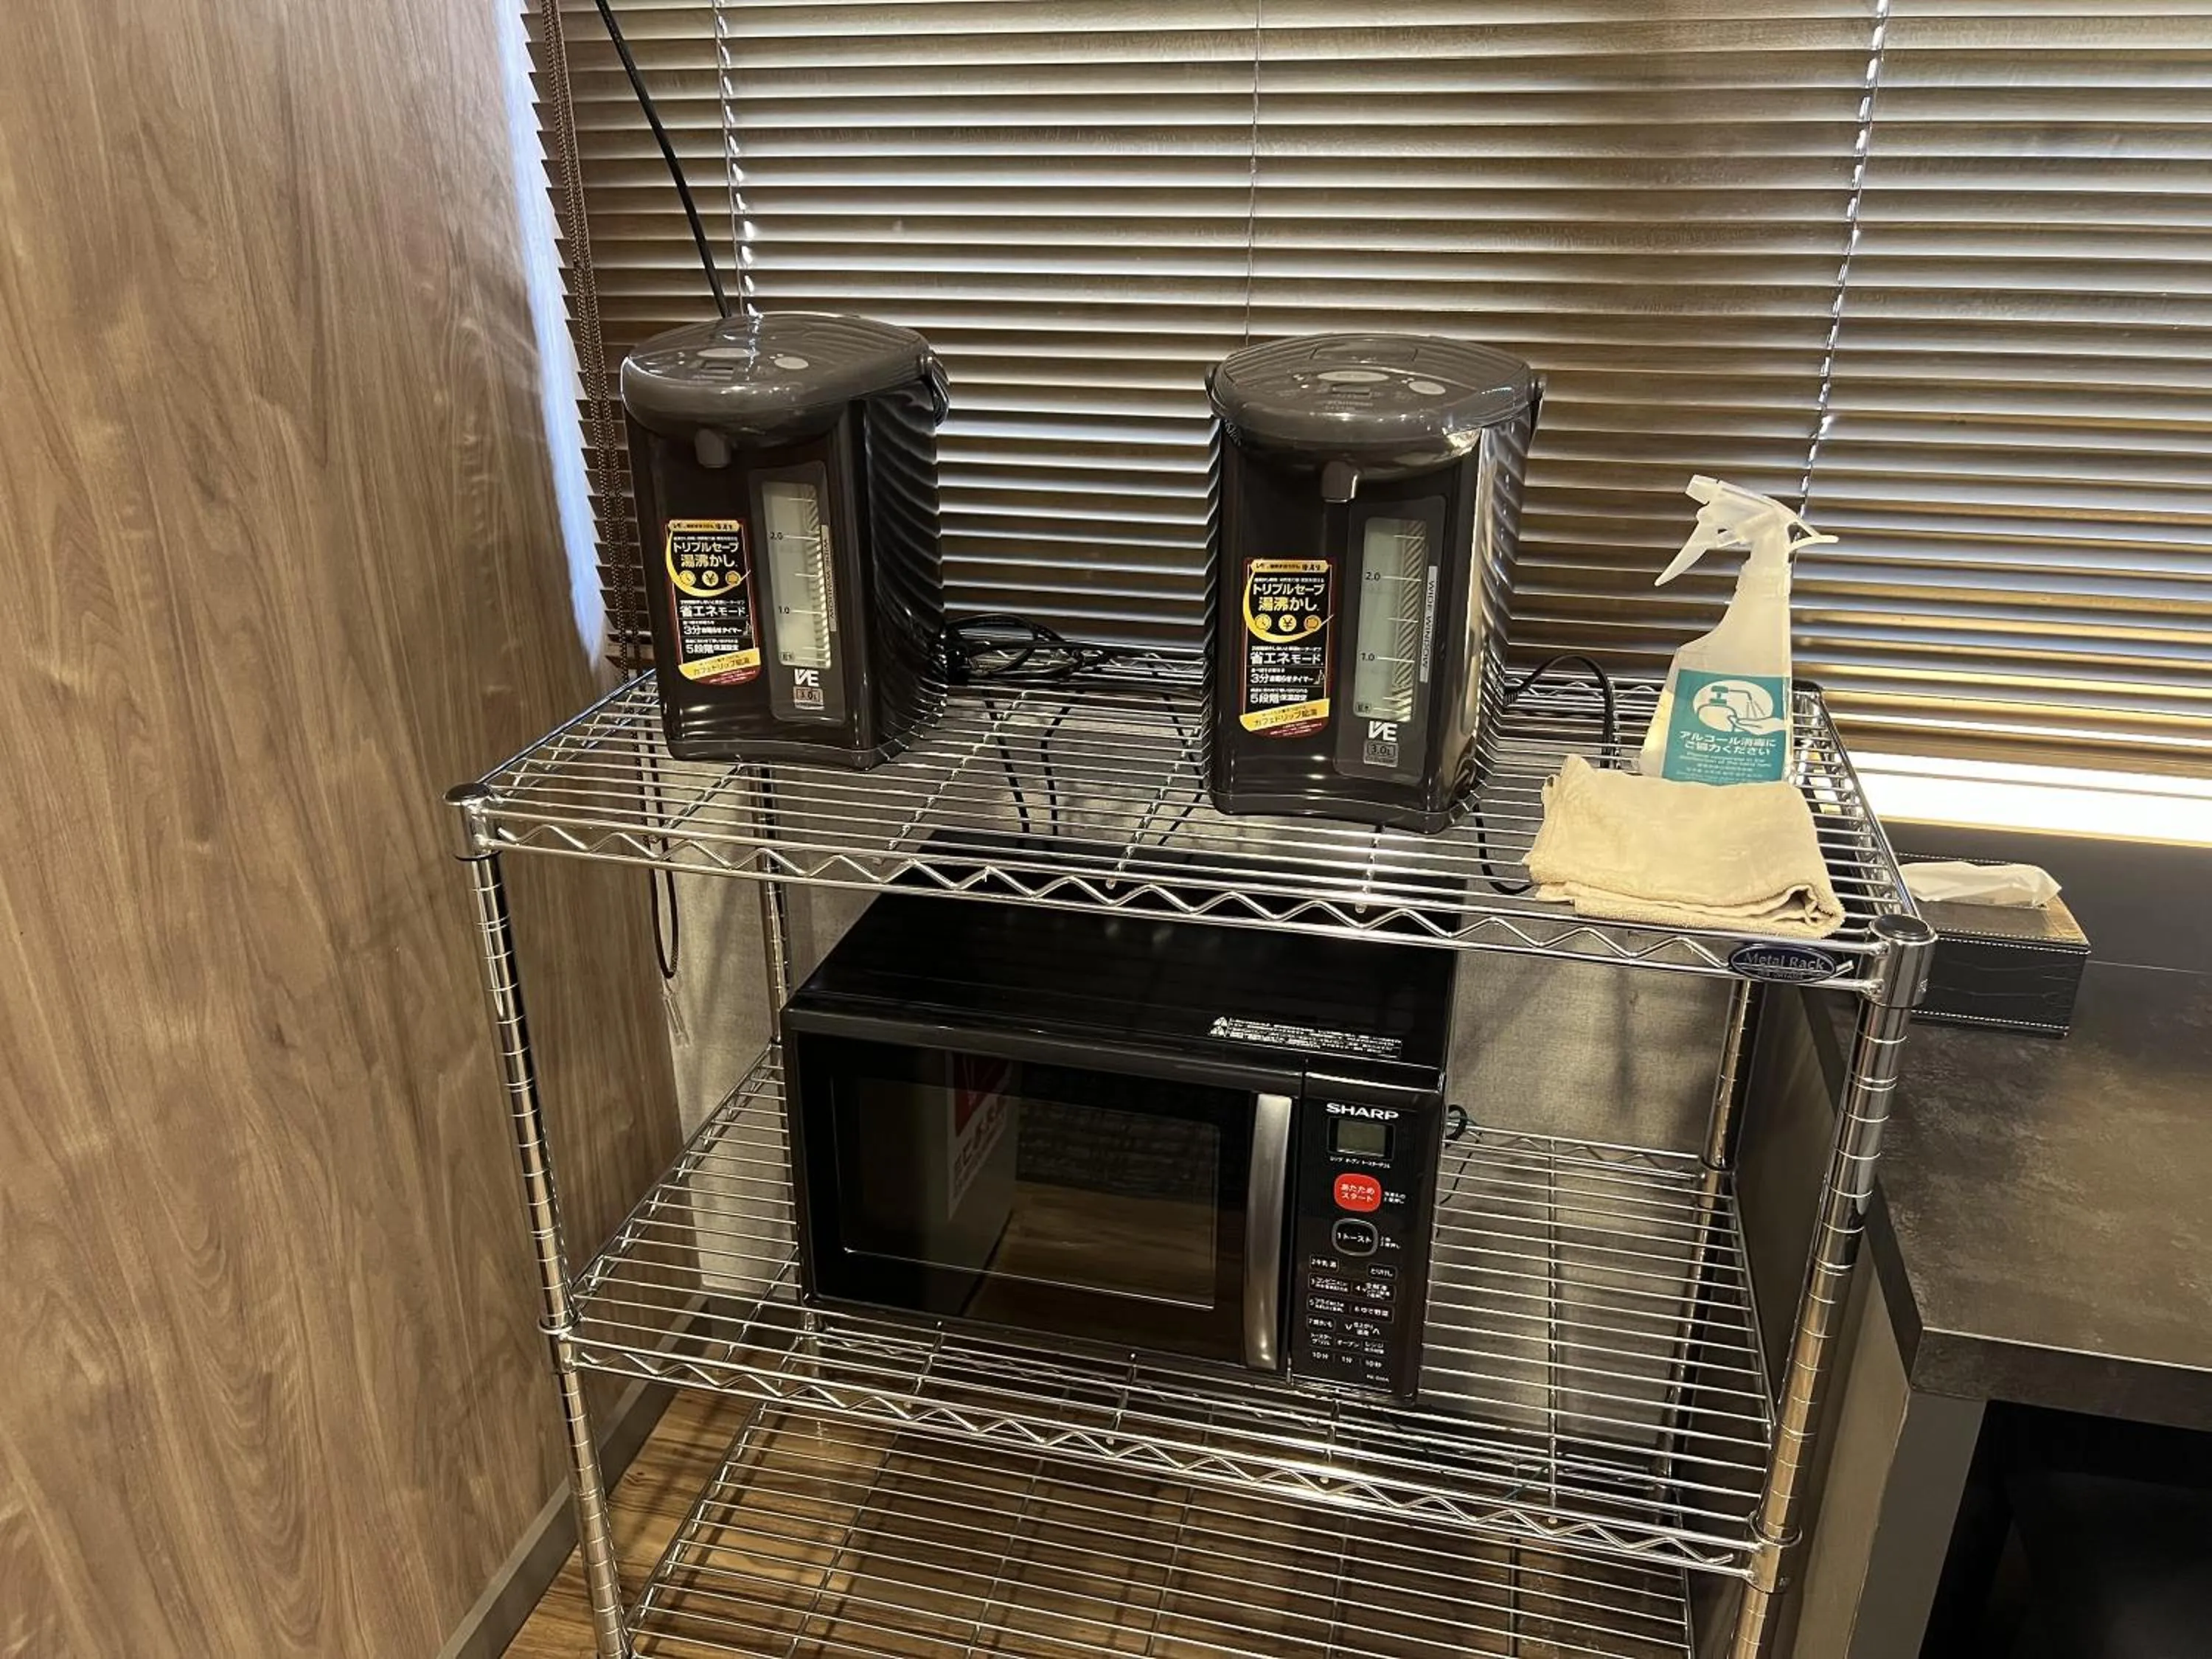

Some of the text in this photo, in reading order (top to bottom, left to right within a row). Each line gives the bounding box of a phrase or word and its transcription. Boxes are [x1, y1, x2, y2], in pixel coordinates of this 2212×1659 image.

[1366, 571, 1381, 581] 2.0
[679, 605, 746, 617] 省エネモード
[778, 606, 790, 615] 1.0
[1423, 615, 1431, 668] WINDOW
[1250, 652, 1322, 664] 省エネモード
[1361, 653, 1375, 661] 1.0
[1679, 731, 1777, 748] アルコール消毒に
[1684, 741, 1770, 756] ご協力ください
[1745, 952, 1823, 970] Metal Rack
[1326, 1102, 1399, 1120] SHARP
[1340, 1183, 1375, 1195] あたため
[1342, 1192, 1374, 1203] スタート
